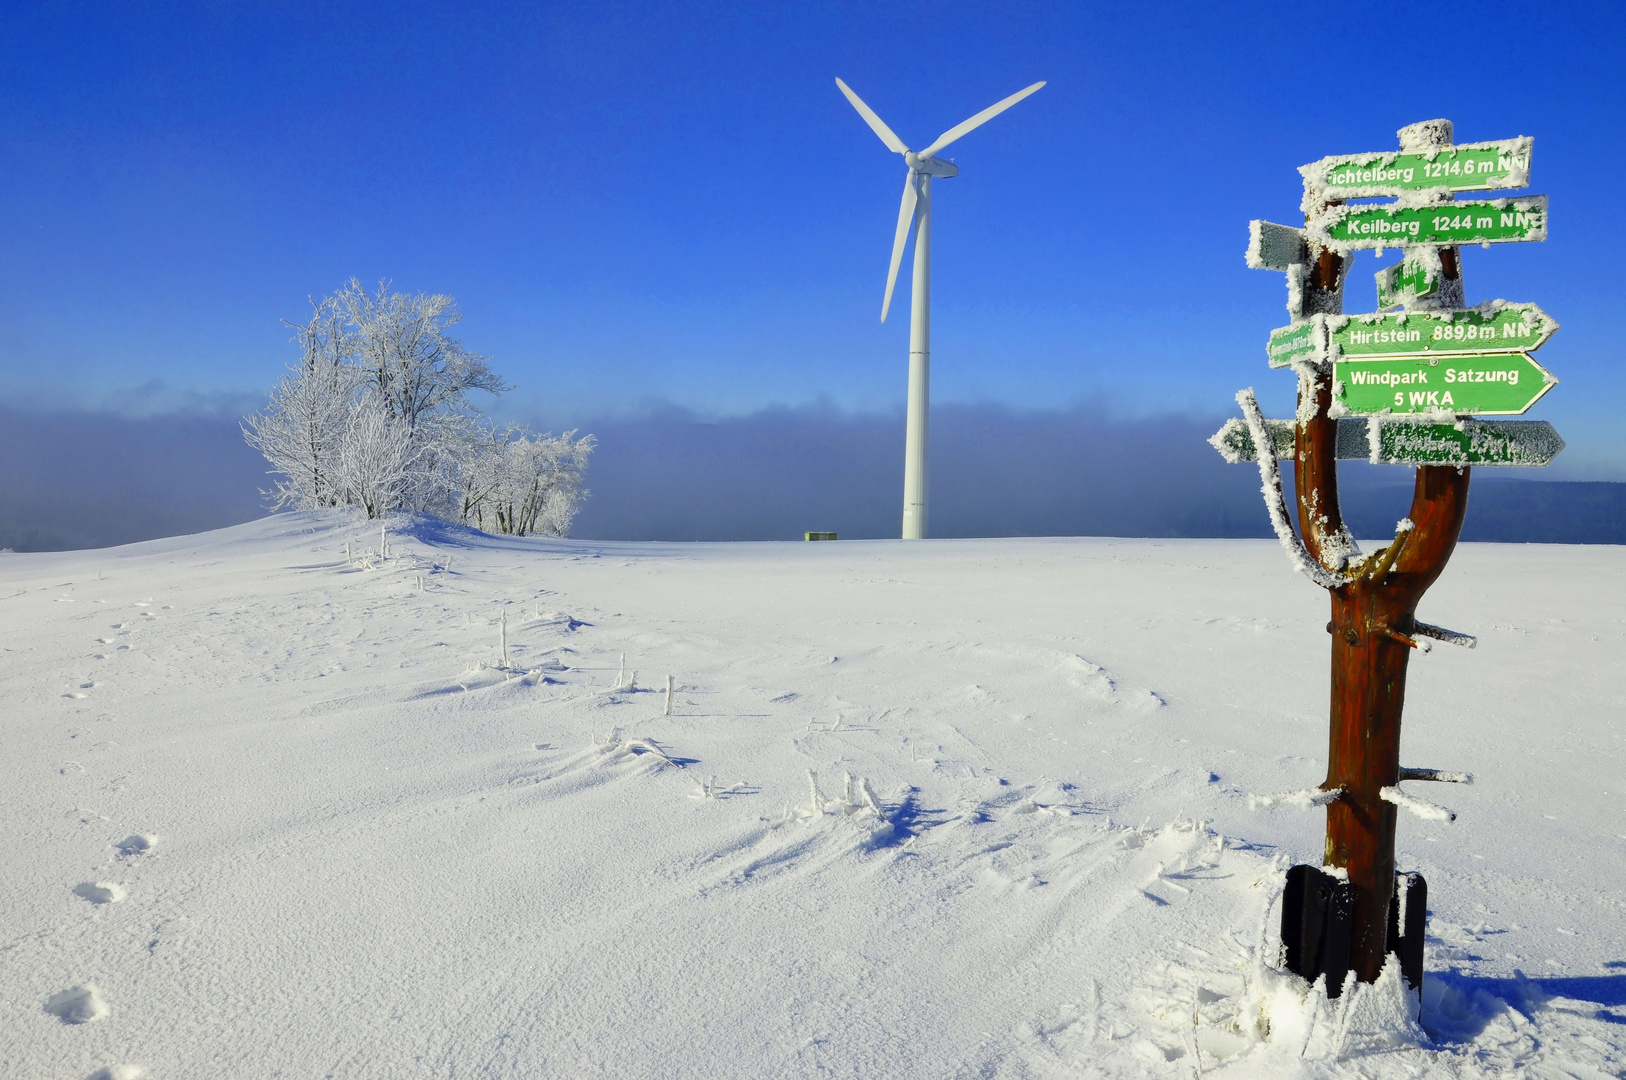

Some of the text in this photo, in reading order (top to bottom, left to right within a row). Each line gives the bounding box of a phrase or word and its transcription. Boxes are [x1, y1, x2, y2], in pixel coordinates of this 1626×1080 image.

[1423, 159, 1475, 178] 1214,6
[1477, 161, 1494, 173] m
[1347, 212, 1528, 235] Keilberg 1244 m NN
[1350, 322, 1531, 345] Hirtstein 889,8 m NN
[1351, 368, 1519, 388] Windpark Satzung
[1394, 391, 1454, 406] 5 WKA
